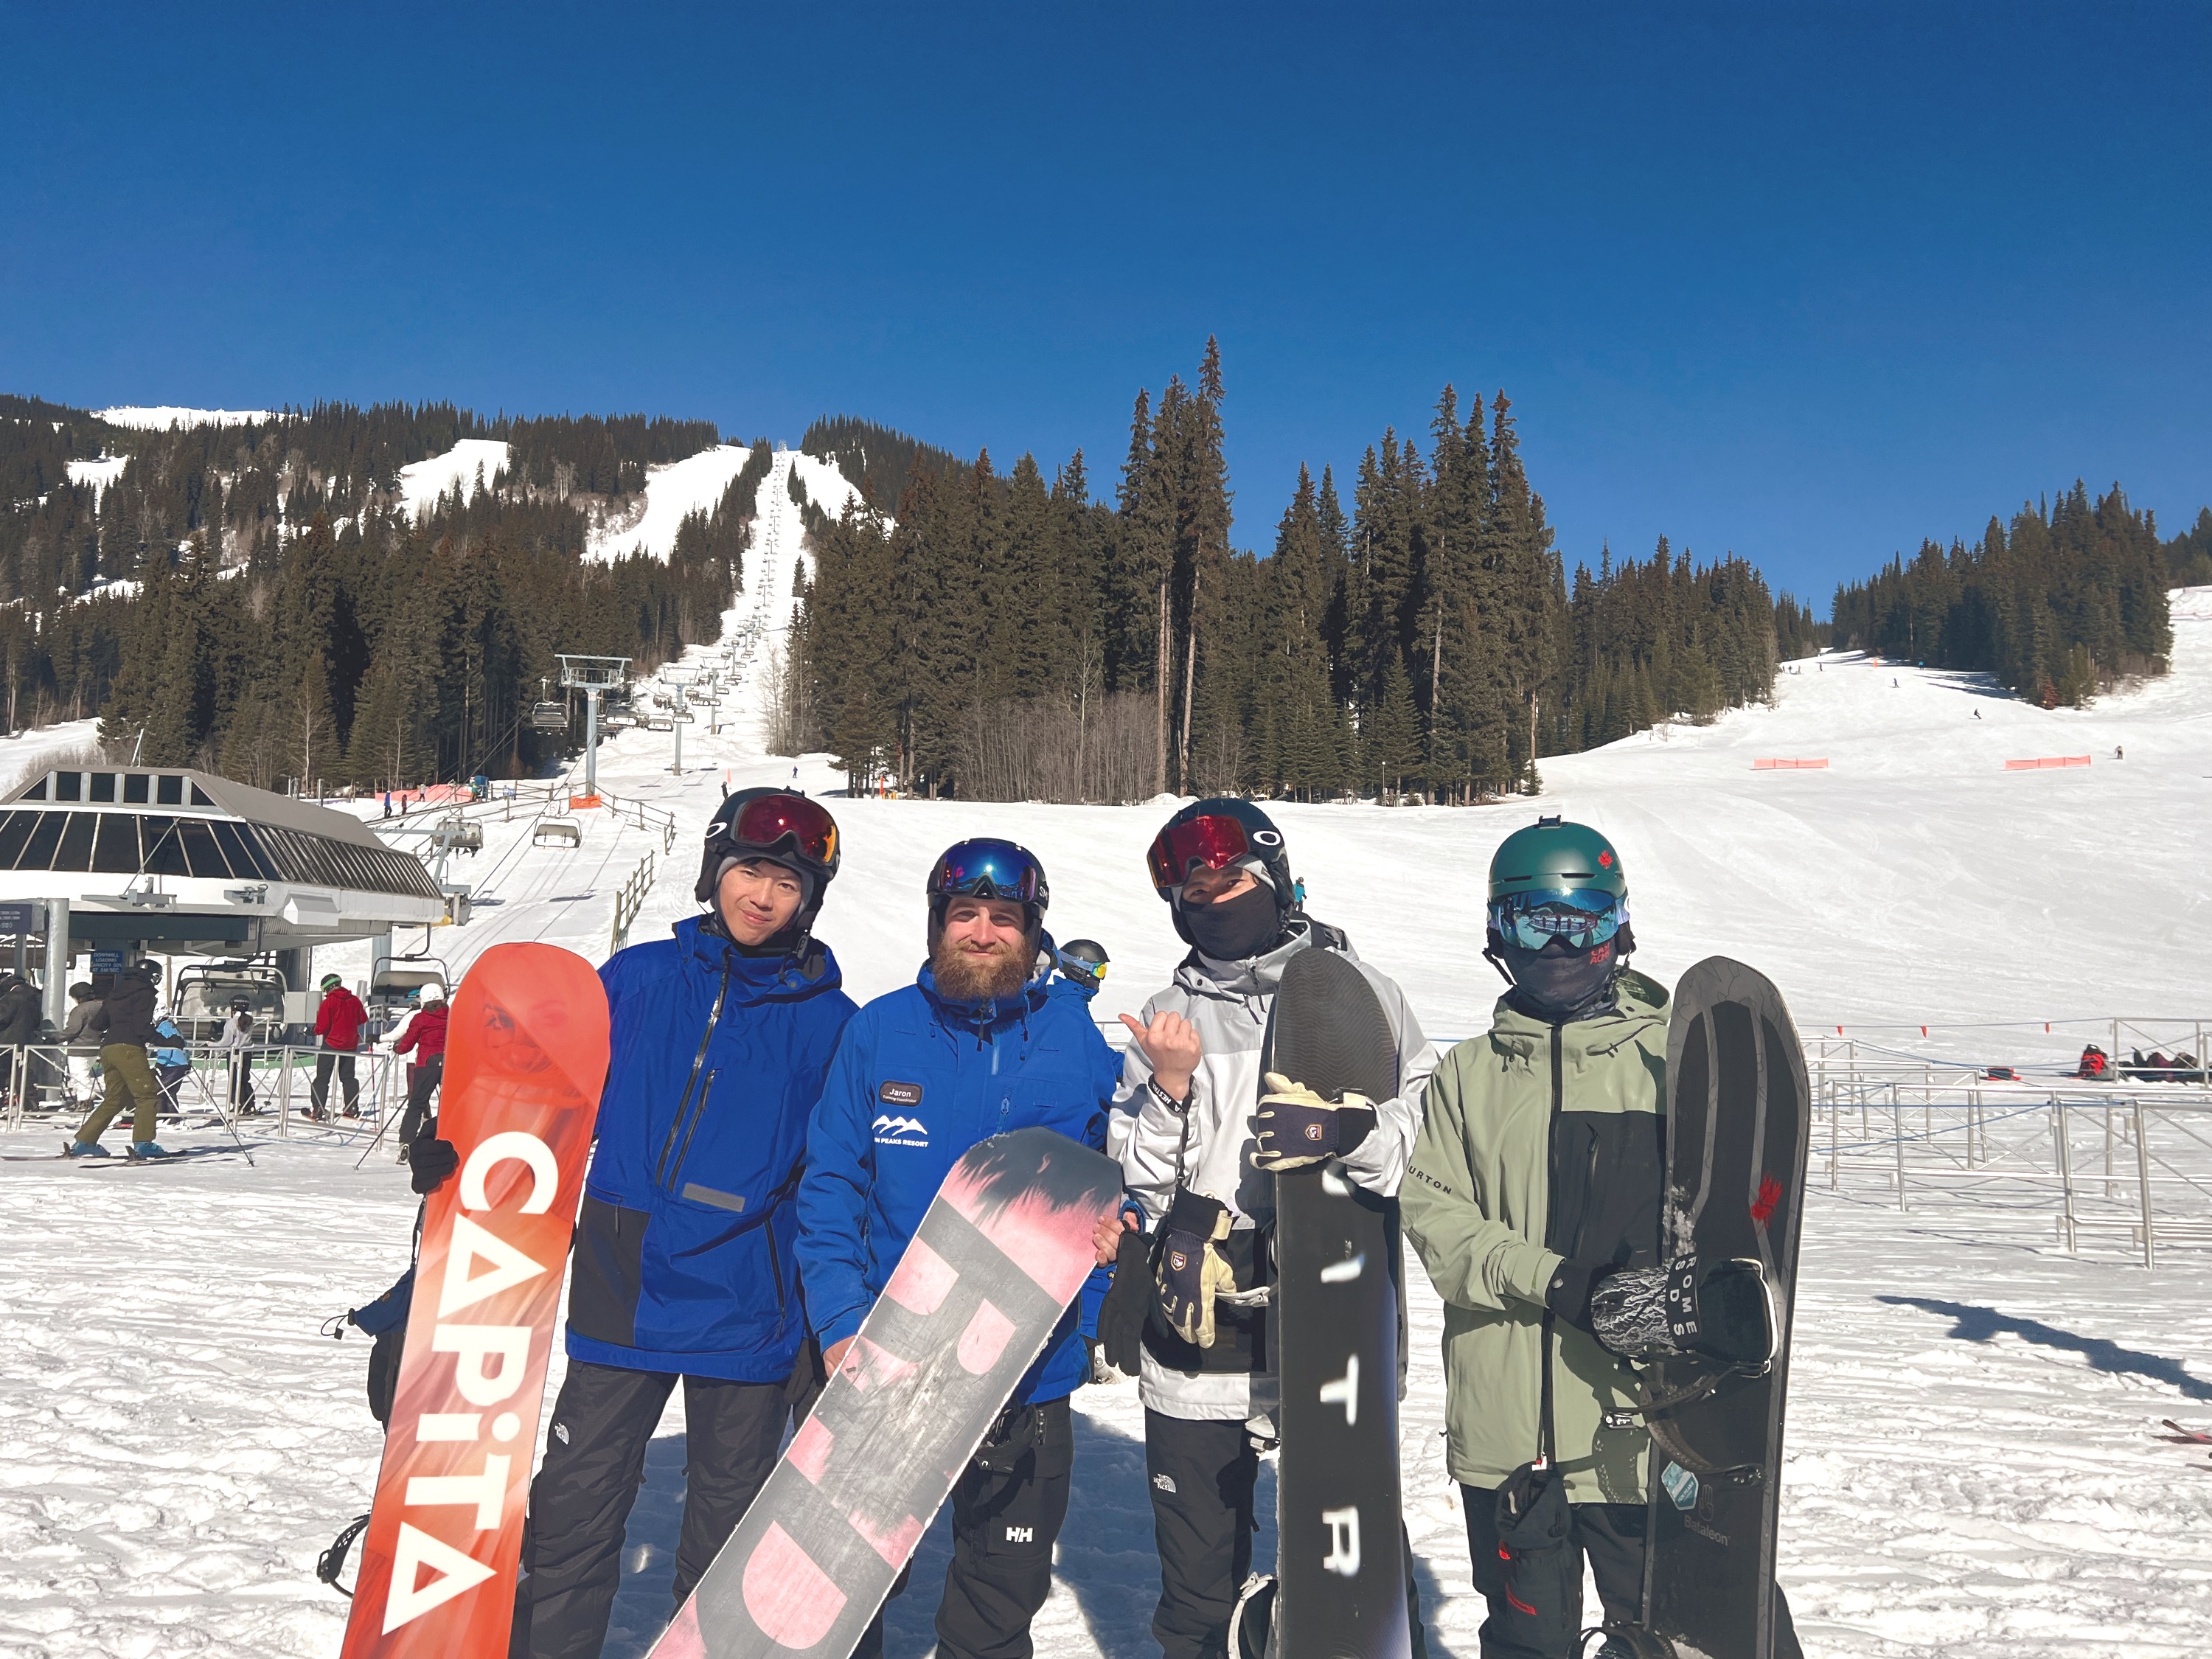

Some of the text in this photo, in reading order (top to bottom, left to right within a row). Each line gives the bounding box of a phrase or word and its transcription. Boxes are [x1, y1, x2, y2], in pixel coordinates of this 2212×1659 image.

[889, 1088, 911, 1098] Jaron
[880, 1138, 902, 1146] PEAKS
[902, 1139, 929, 1148] RESORT
[1408, 1165, 1452, 1194] URTON
[1669, 1260, 1685, 1336] SDS
[1682, 1256, 1697, 1334] ROME
[1006, 1527, 1033, 1542] HH
[1684, 1514, 1728, 1546] Bataleon
